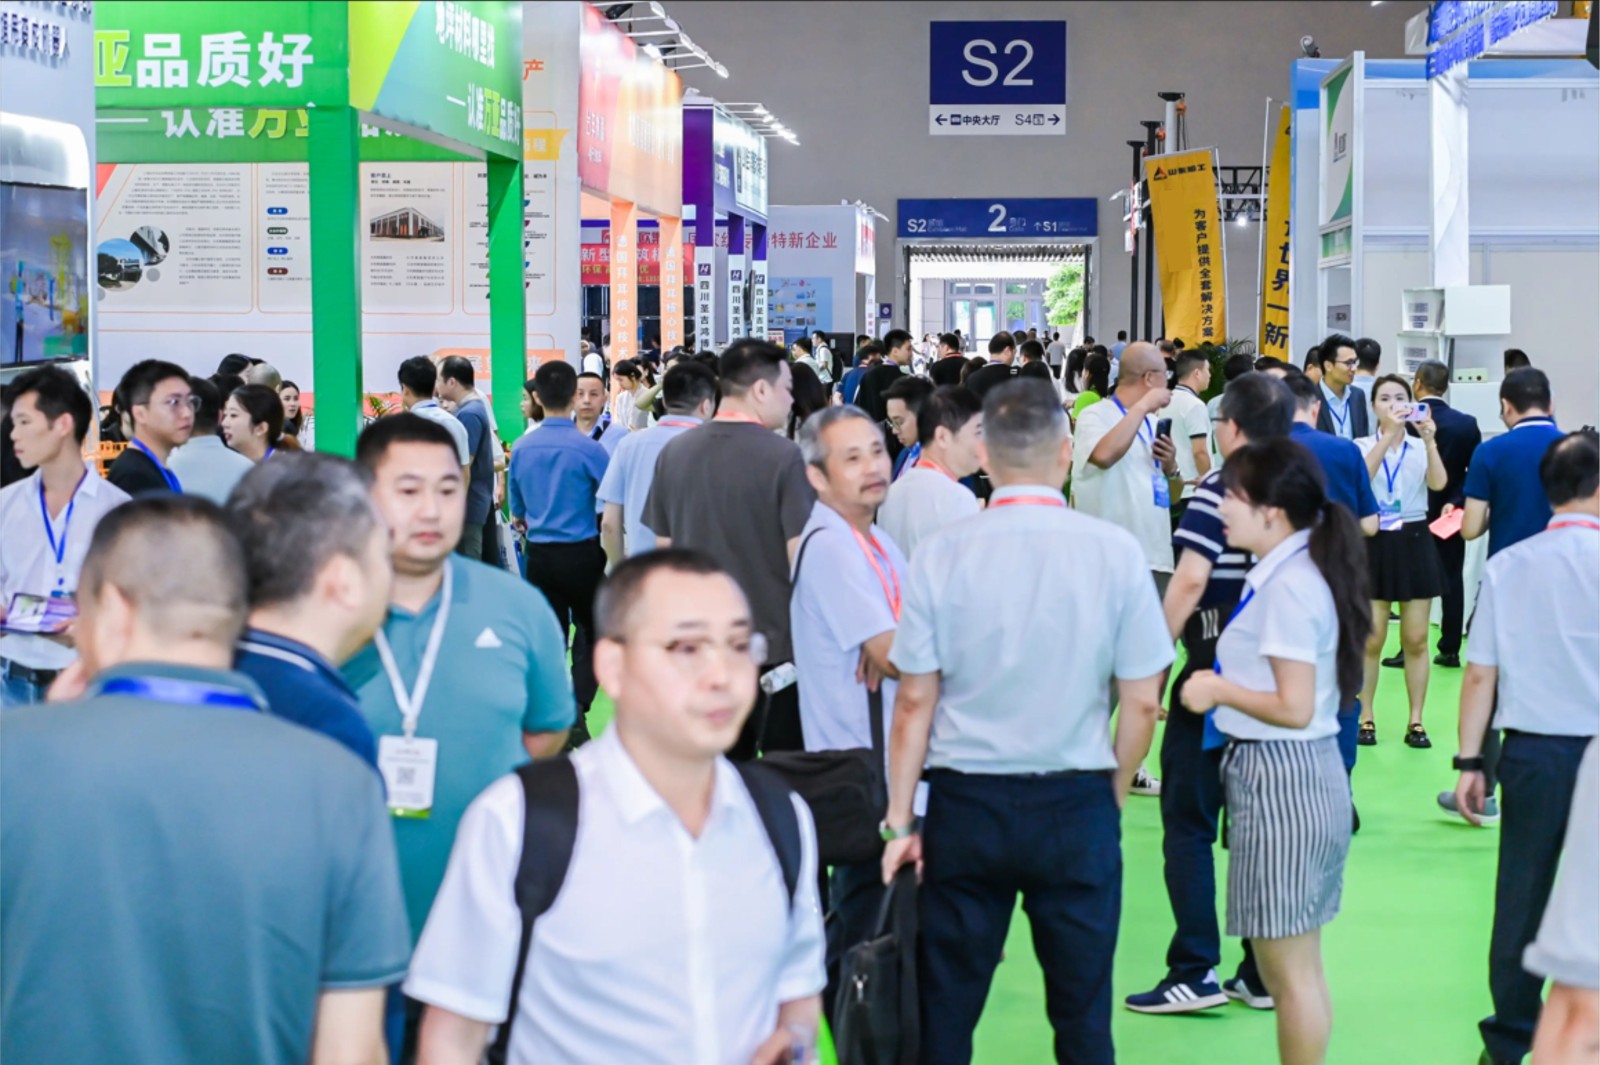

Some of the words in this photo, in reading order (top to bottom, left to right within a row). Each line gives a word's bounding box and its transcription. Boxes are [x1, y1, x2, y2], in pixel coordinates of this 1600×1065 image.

[94, 29, 314, 88] 亚品质好
[962, 39, 1034, 87] S2
[523, 59, 544, 80] 产
[963, 115, 1000, 126] 中央大厅
[1015, 114, 1032, 126] S4
[907, 218, 927, 233] S2
[987, 204, 1007, 233] 2
[1042, 221, 1057, 233] S1
[1194, 208, 1213, 337] 为客户提供全套解决方案
